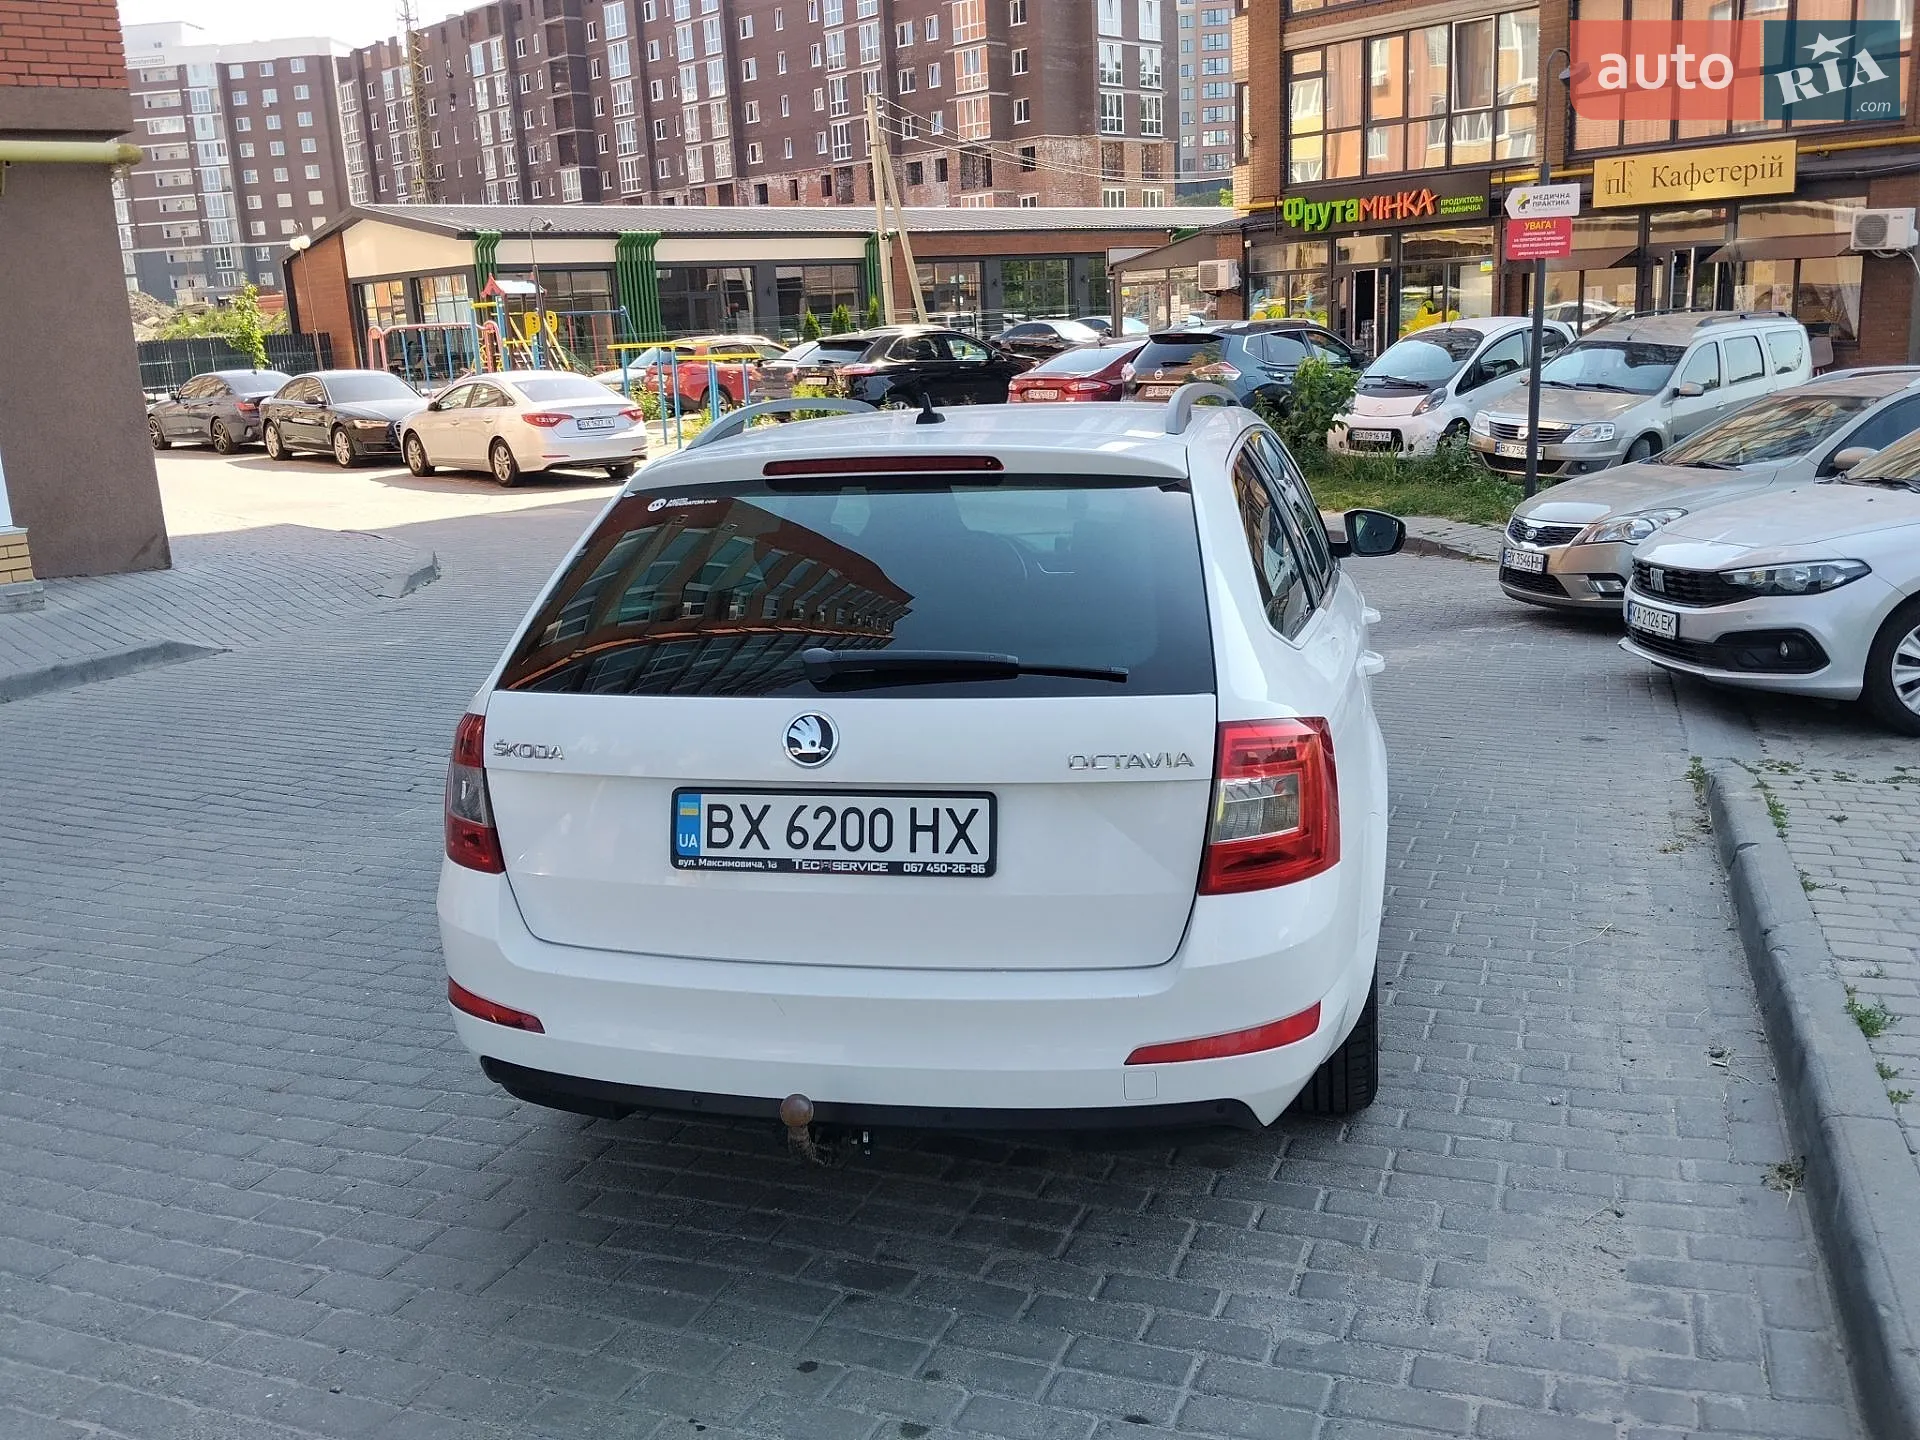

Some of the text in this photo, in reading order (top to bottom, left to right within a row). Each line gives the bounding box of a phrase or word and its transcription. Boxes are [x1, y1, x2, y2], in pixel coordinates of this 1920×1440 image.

[1652, 155, 1783, 191] Кафетерій
[1440, 195, 1484, 206] ПРОДУКТОВА
[1532, 192, 1571, 201] МЕДИЧНА
[1532, 199, 1570, 207] ПРАКТИКА
[1440, 204, 1481, 215] КРАМНИЧКА
[1642, 610, 1660, 629] 2126
[1661, 614, 1674, 633] EK
[493, 739, 564, 760] ŠKODA
[1068, 752, 1195, 770] OCTAVIA
[678, 803, 979, 855] UA BX 6200 HX
[678, 859, 697, 868] вул.
[903, 862, 986, 874] 067 450-26-86
